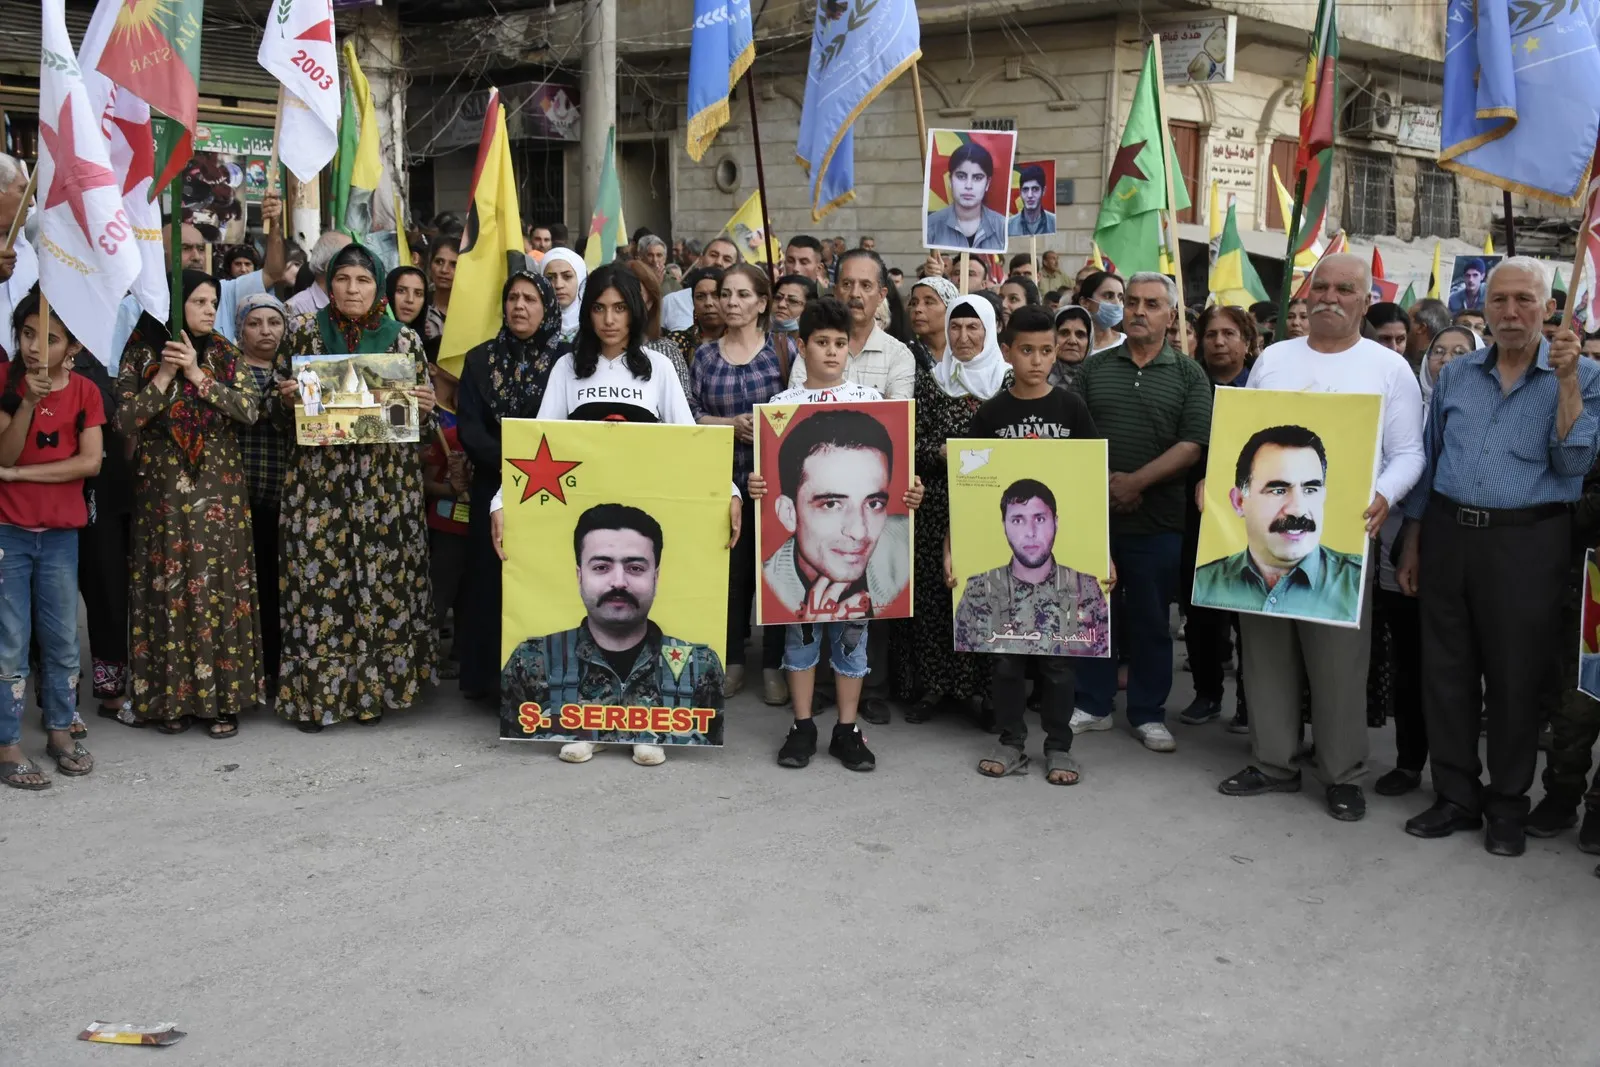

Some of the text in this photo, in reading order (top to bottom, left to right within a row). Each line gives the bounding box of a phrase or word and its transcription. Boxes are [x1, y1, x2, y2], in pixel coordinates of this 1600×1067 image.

[290, 49, 334, 91] 2003
[241, 137, 273, 156] نظفات
[577, 386, 643, 400] FRENCH
[1004, 423, 1062, 438] ARMY
[512, 474, 577, 505] Y P G
[986, 623, 1042, 643] صقر
[518, 701, 716, 734] Ş. SERBEST
